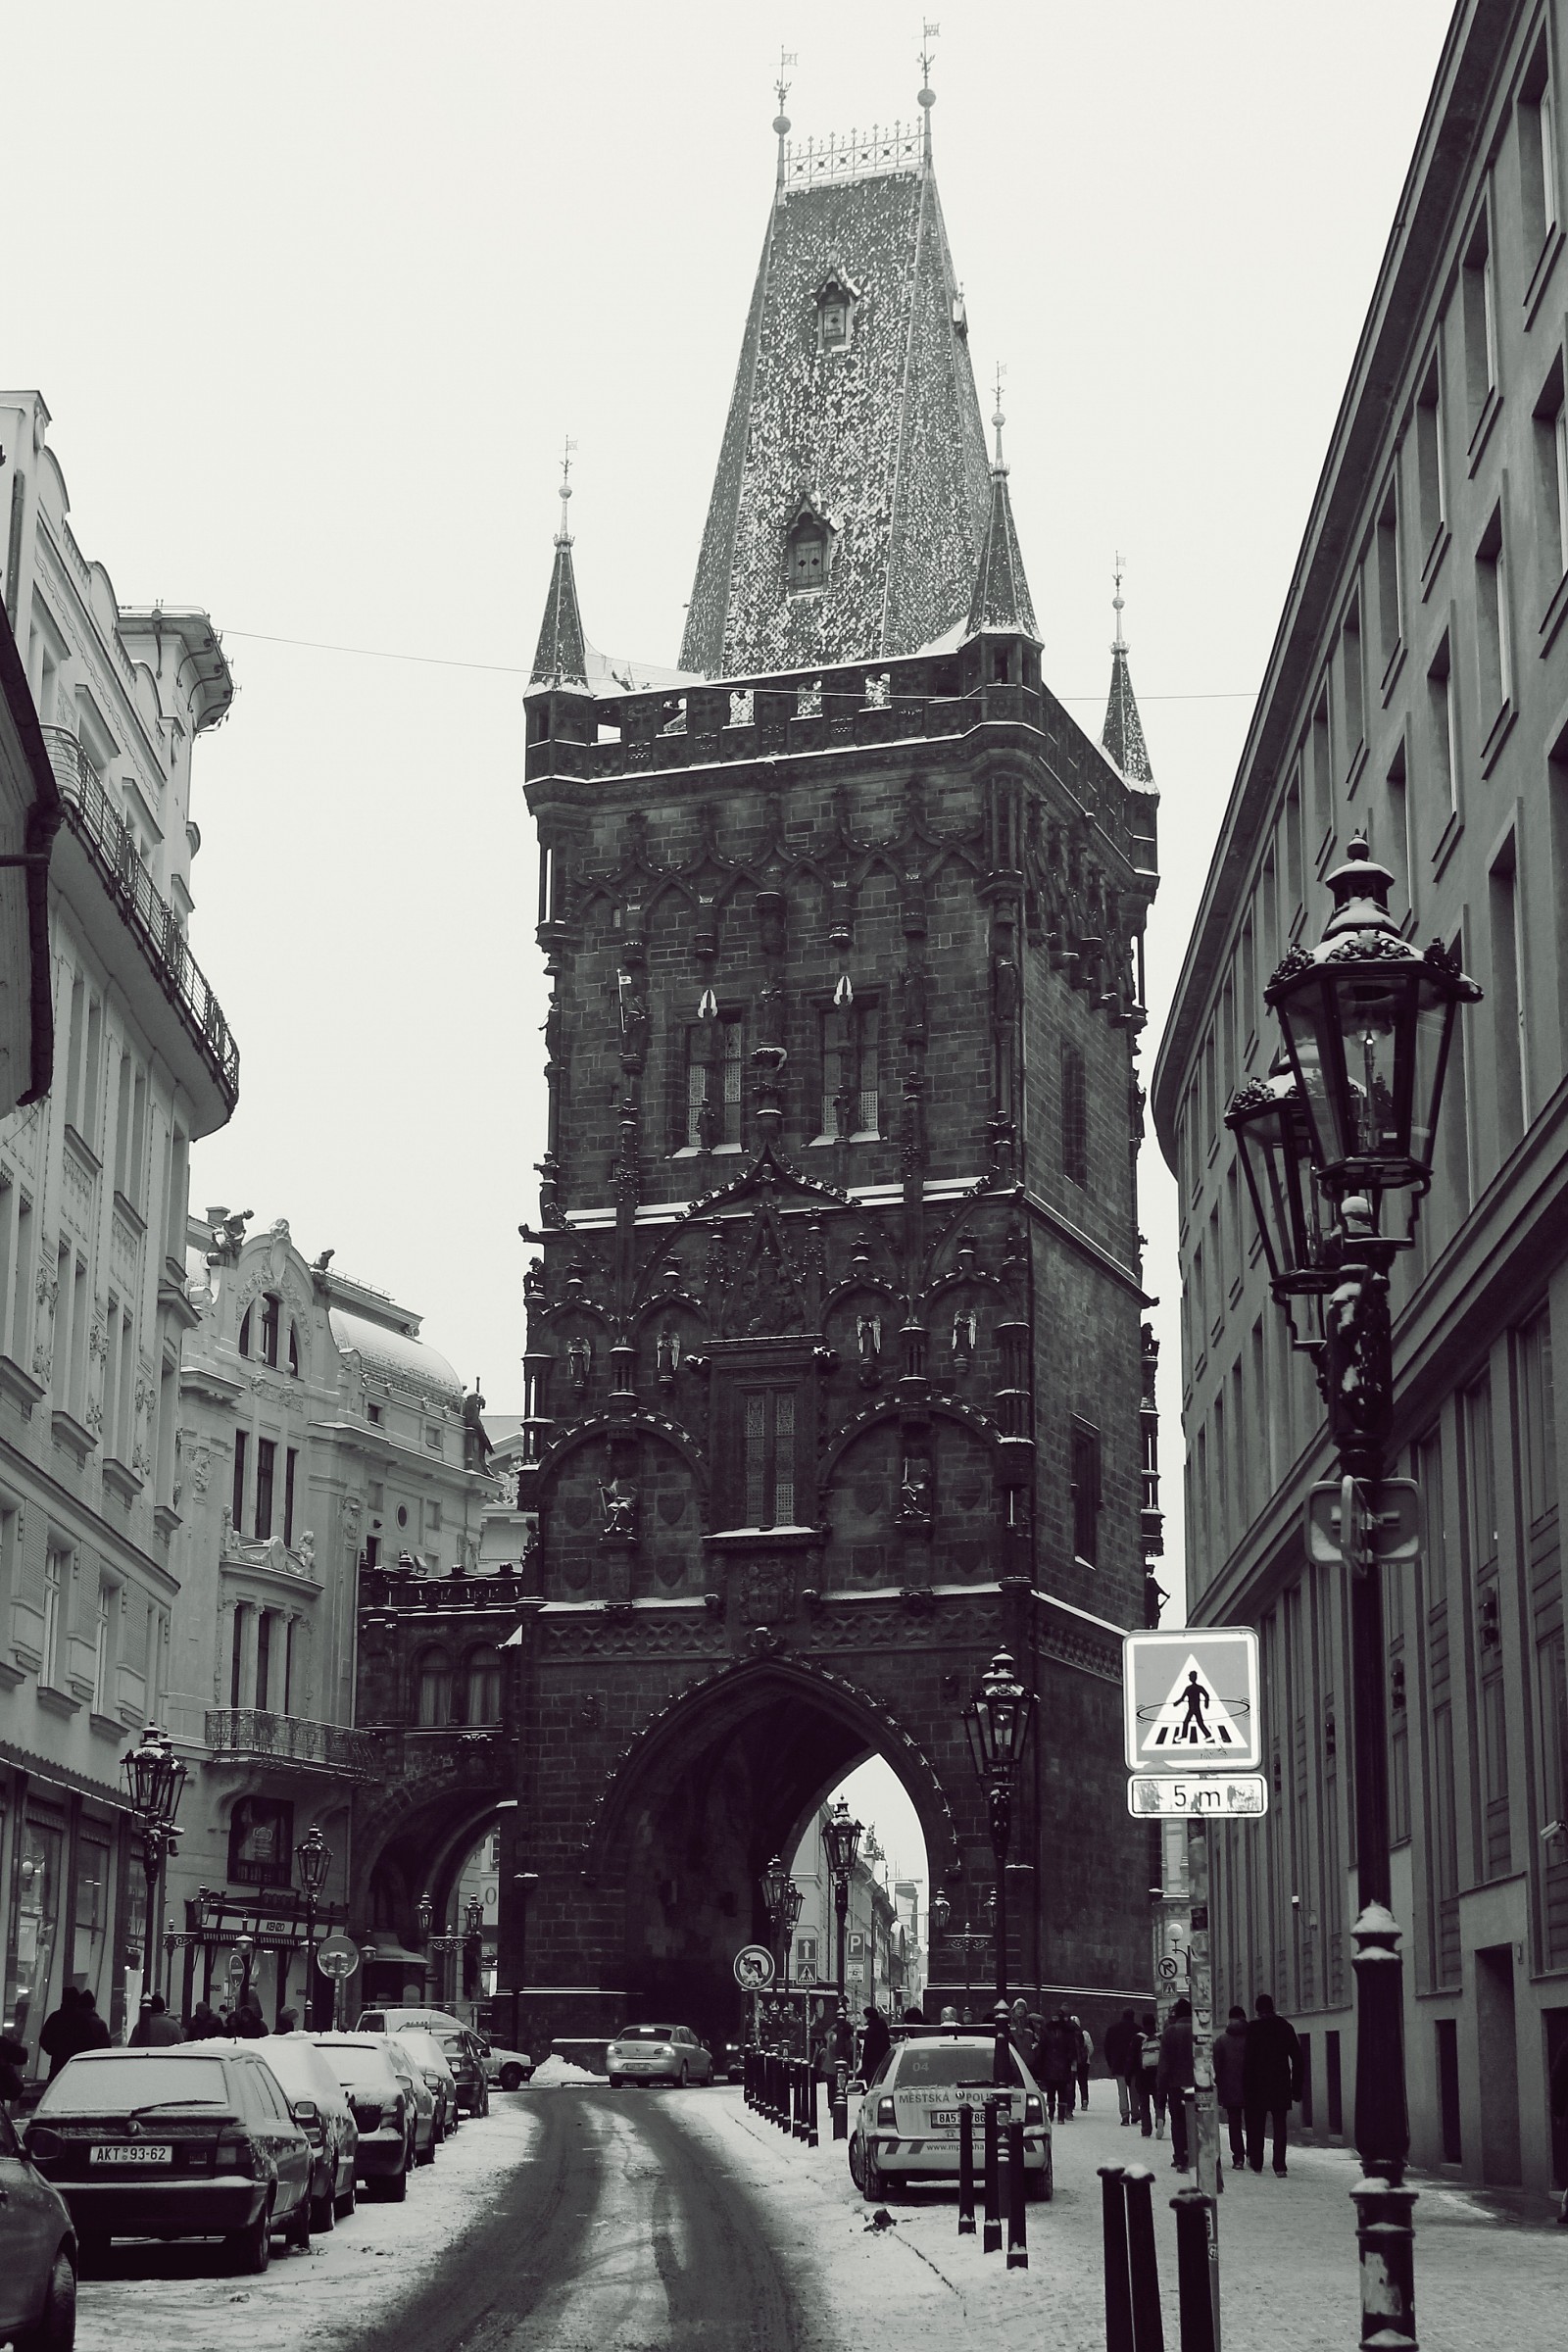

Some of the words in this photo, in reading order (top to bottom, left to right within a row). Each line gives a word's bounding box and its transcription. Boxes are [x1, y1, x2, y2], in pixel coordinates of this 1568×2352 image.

[1174, 1785, 1187, 1807] 5
[1199, 1789, 1221, 1807] m
[266, 1921, 286, 1933] KENZO
[851, 1935, 861, 1953] P
[912, 2062, 929, 2073] 04
[939, 2114, 956, 2123] 8A5
[96, 2147, 121, 2161] AKT
[129, 2147, 166, 2161] 93-62
